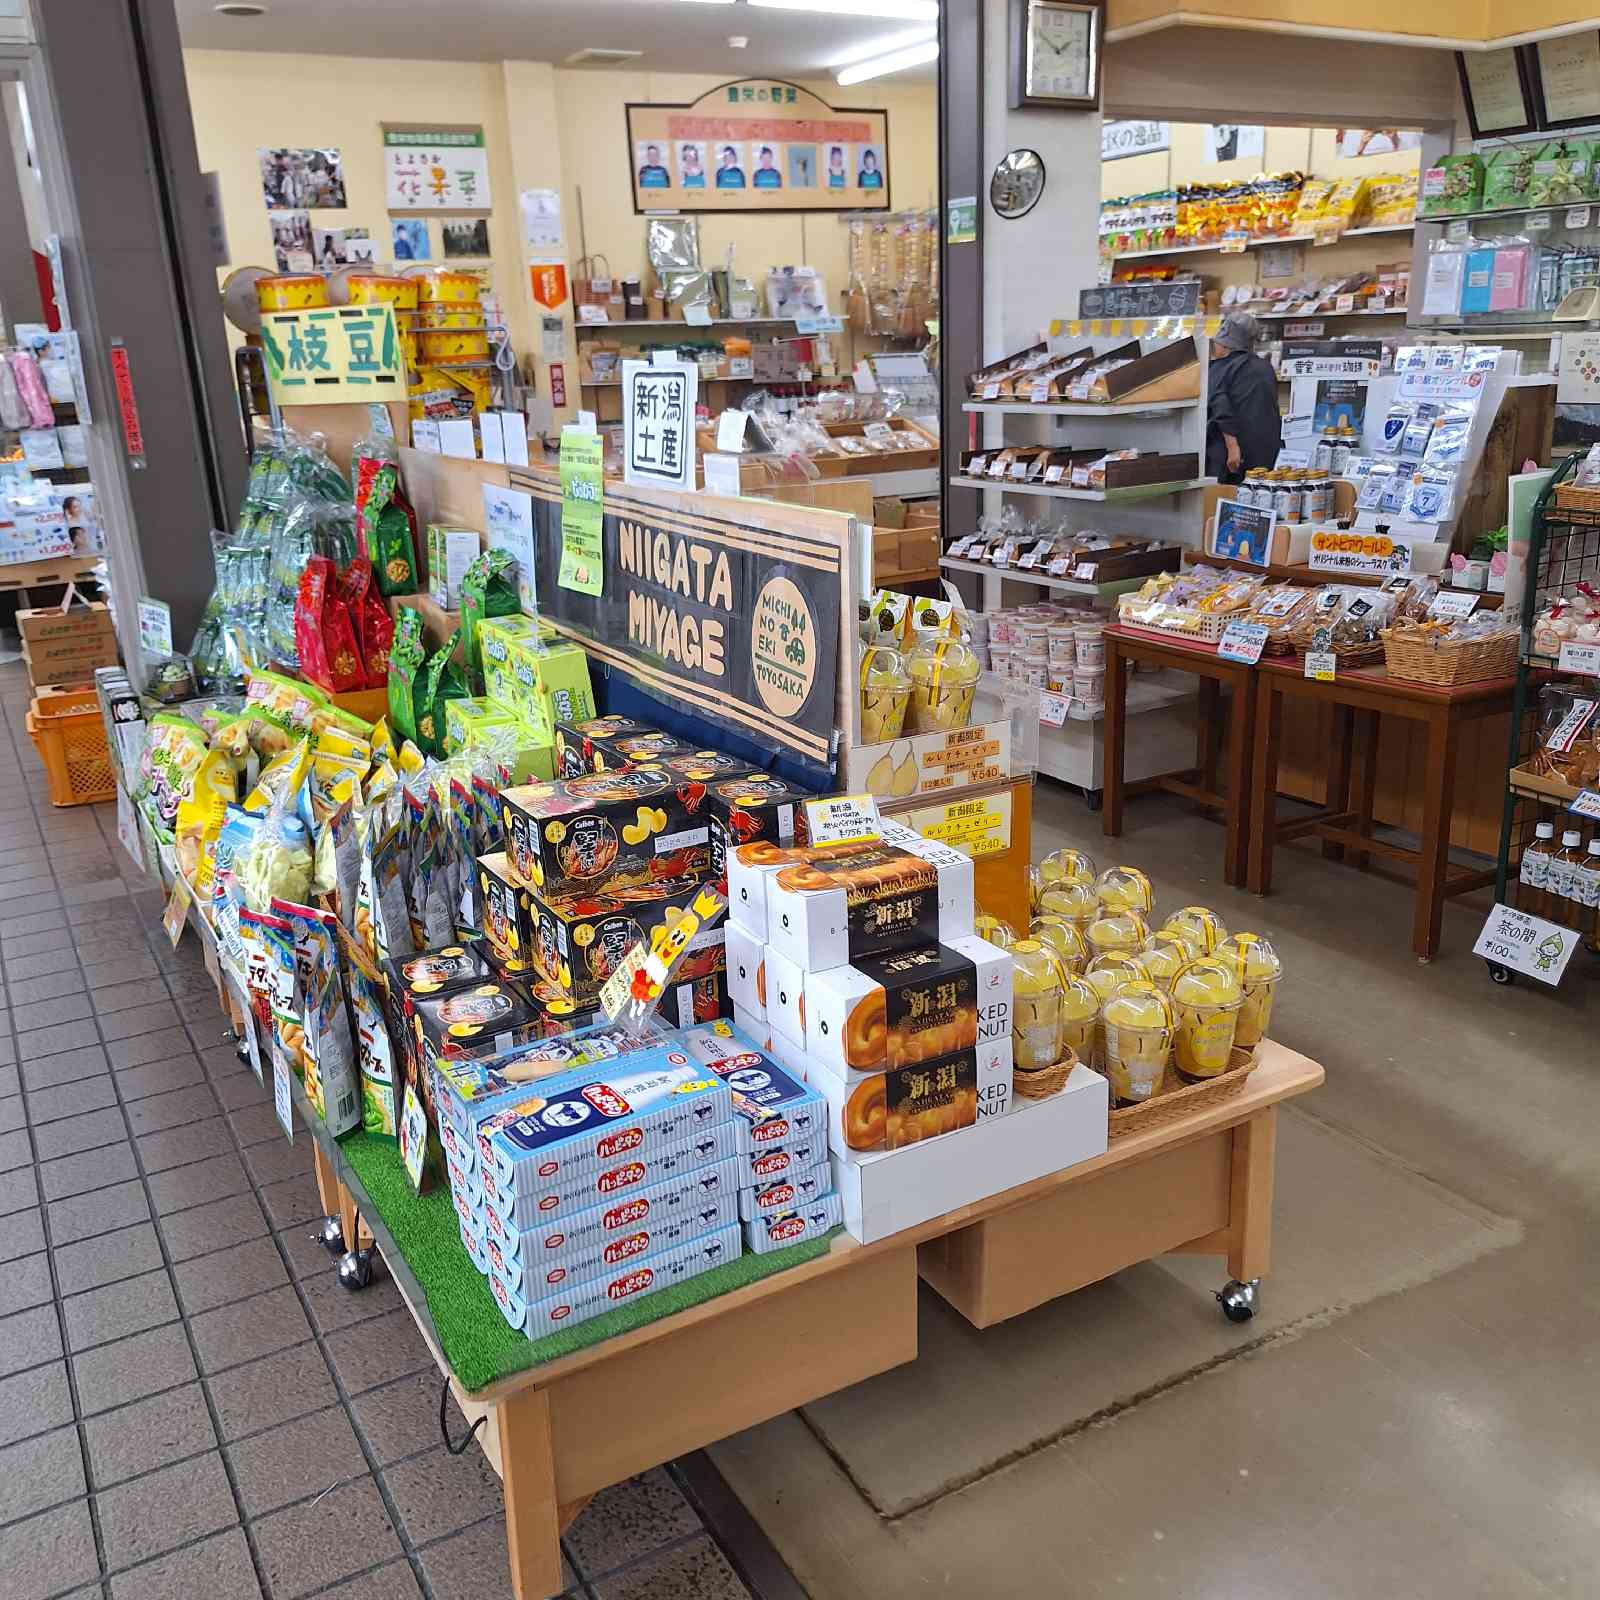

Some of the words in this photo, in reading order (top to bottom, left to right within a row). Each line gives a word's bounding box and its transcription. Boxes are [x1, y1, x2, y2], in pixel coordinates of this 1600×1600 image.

[288, 322, 381, 371] 枝豆
[637, 381, 681, 421] 新潟
[637, 425, 678, 467] 土産
[619, 520, 733, 611] NIIGATA
[762, 593, 791, 625] MICHI
[628, 590, 725, 676] MIYAGE
[759, 616, 775, 632] NO
[758, 635, 777, 656] EKI
[756, 663, 804, 698] TOYOSAKA
[971, 767, 998, 781] ¥540
[839, 827, 862, 838] ¥756
[973, 839, 999, 852] ¥540
[1496, 919, 1537, 944] 茶の間
[1483, 939, 1509, 958] ¥100
[977, 1019, 1008, 1040] NUT
[977, 1100, 1008, 1116] NUT
